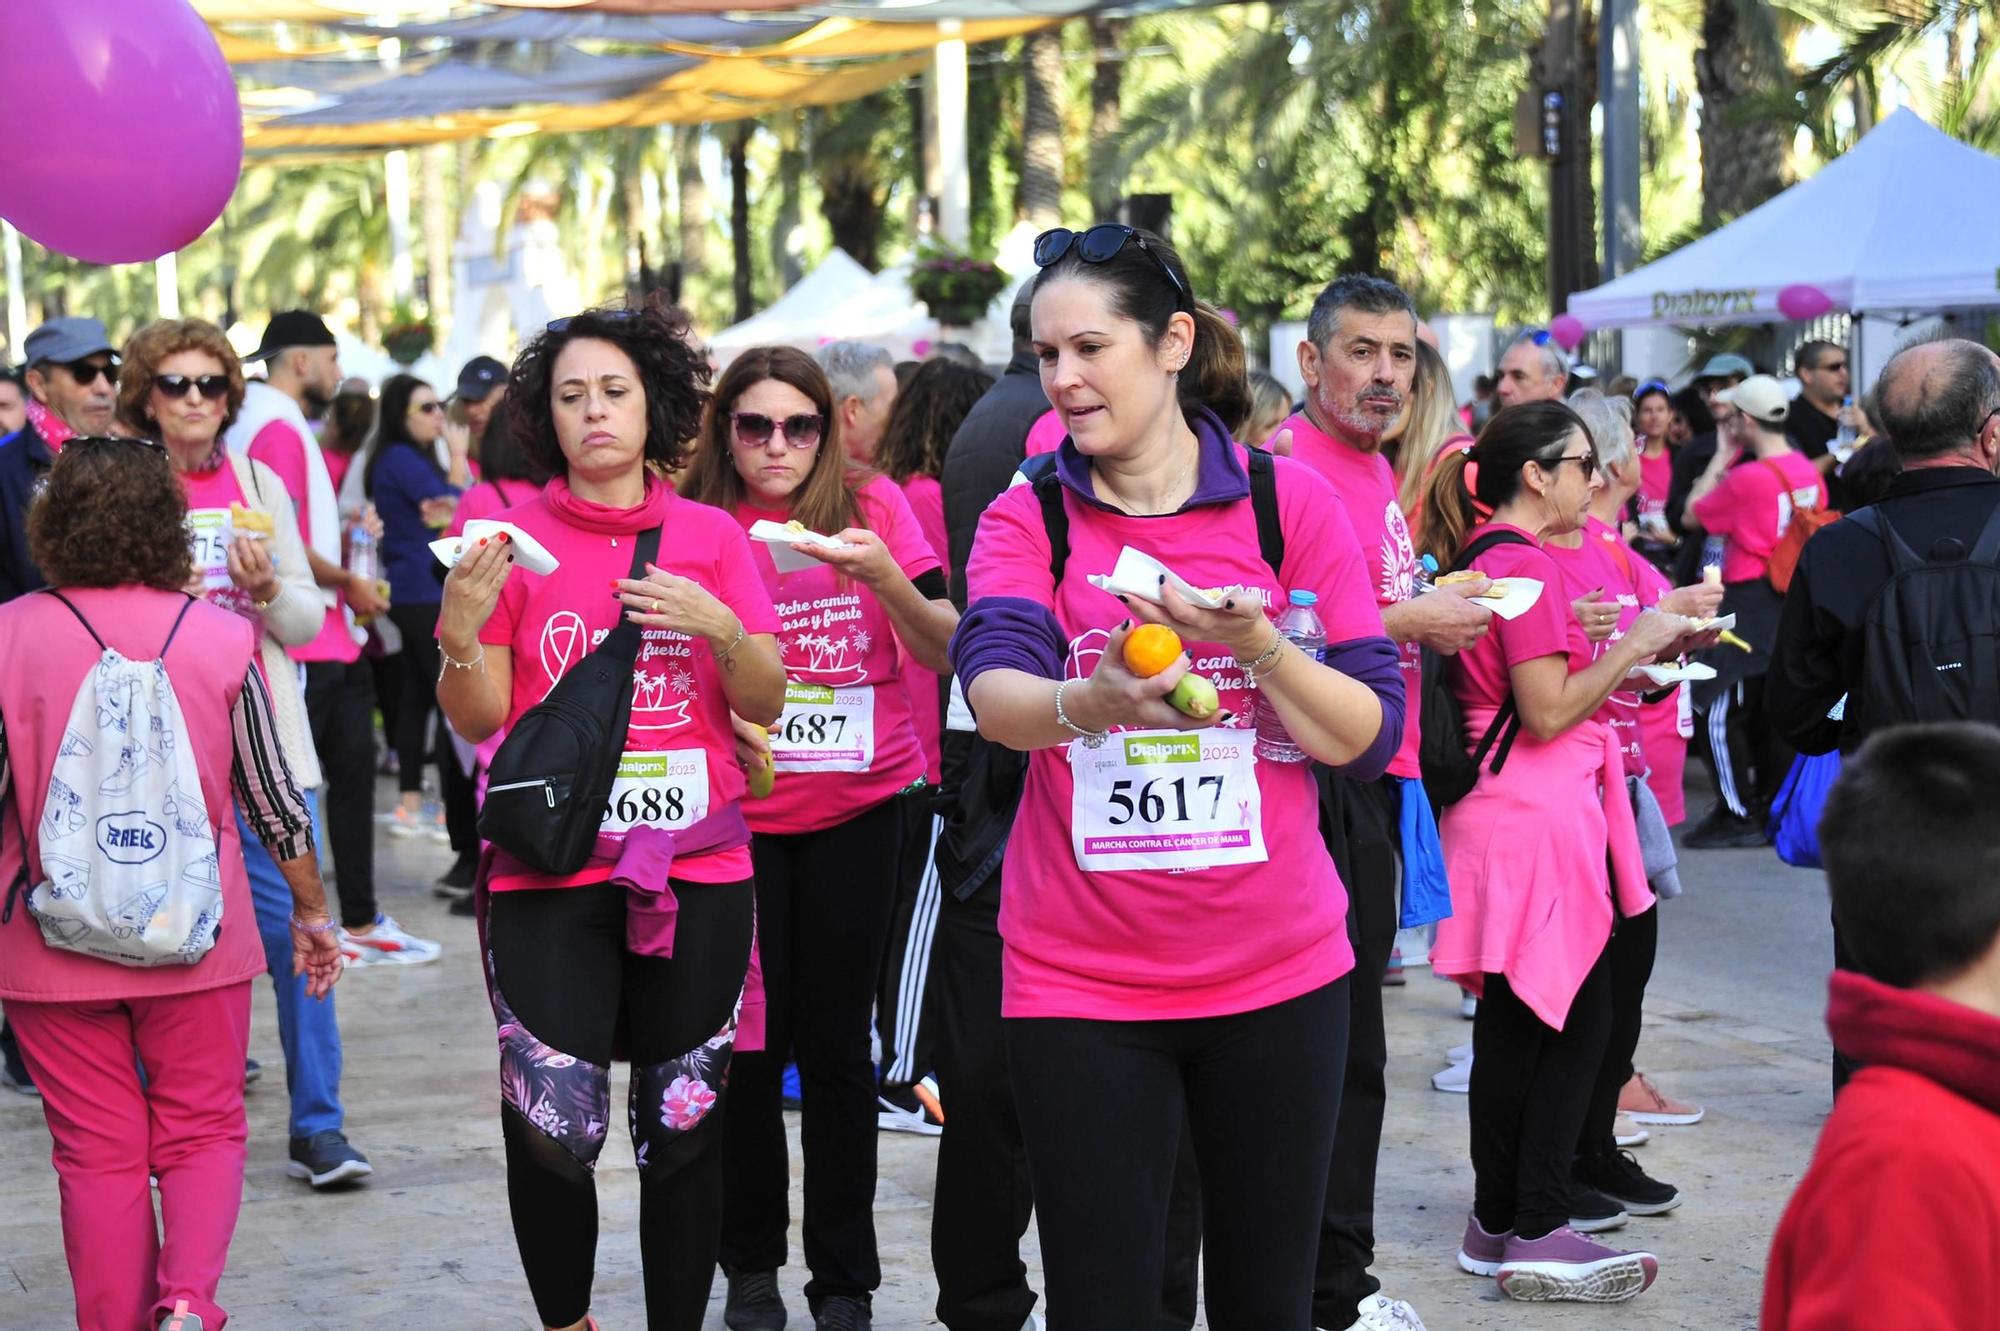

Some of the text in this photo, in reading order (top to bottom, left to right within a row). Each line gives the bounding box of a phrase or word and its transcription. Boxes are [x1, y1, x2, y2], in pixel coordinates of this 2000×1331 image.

[813, 593, 860, 609] camina
[782, 605, 862, 632] osa y fuerte
[642, 641, 692, 662] fuerte
[1196, 656, 1238, 671] cam
[785, 688, 863, 705] Dialprix 2023
[1129, 742, 1240, 760] Dialprix 2023
[669, 764, 697, 776] 2023
[1108, 775, 1224, 825] 5617
[1091, 834, 1243, 850] MARCHA CONTRA EL CÁNCER DE MAMA
